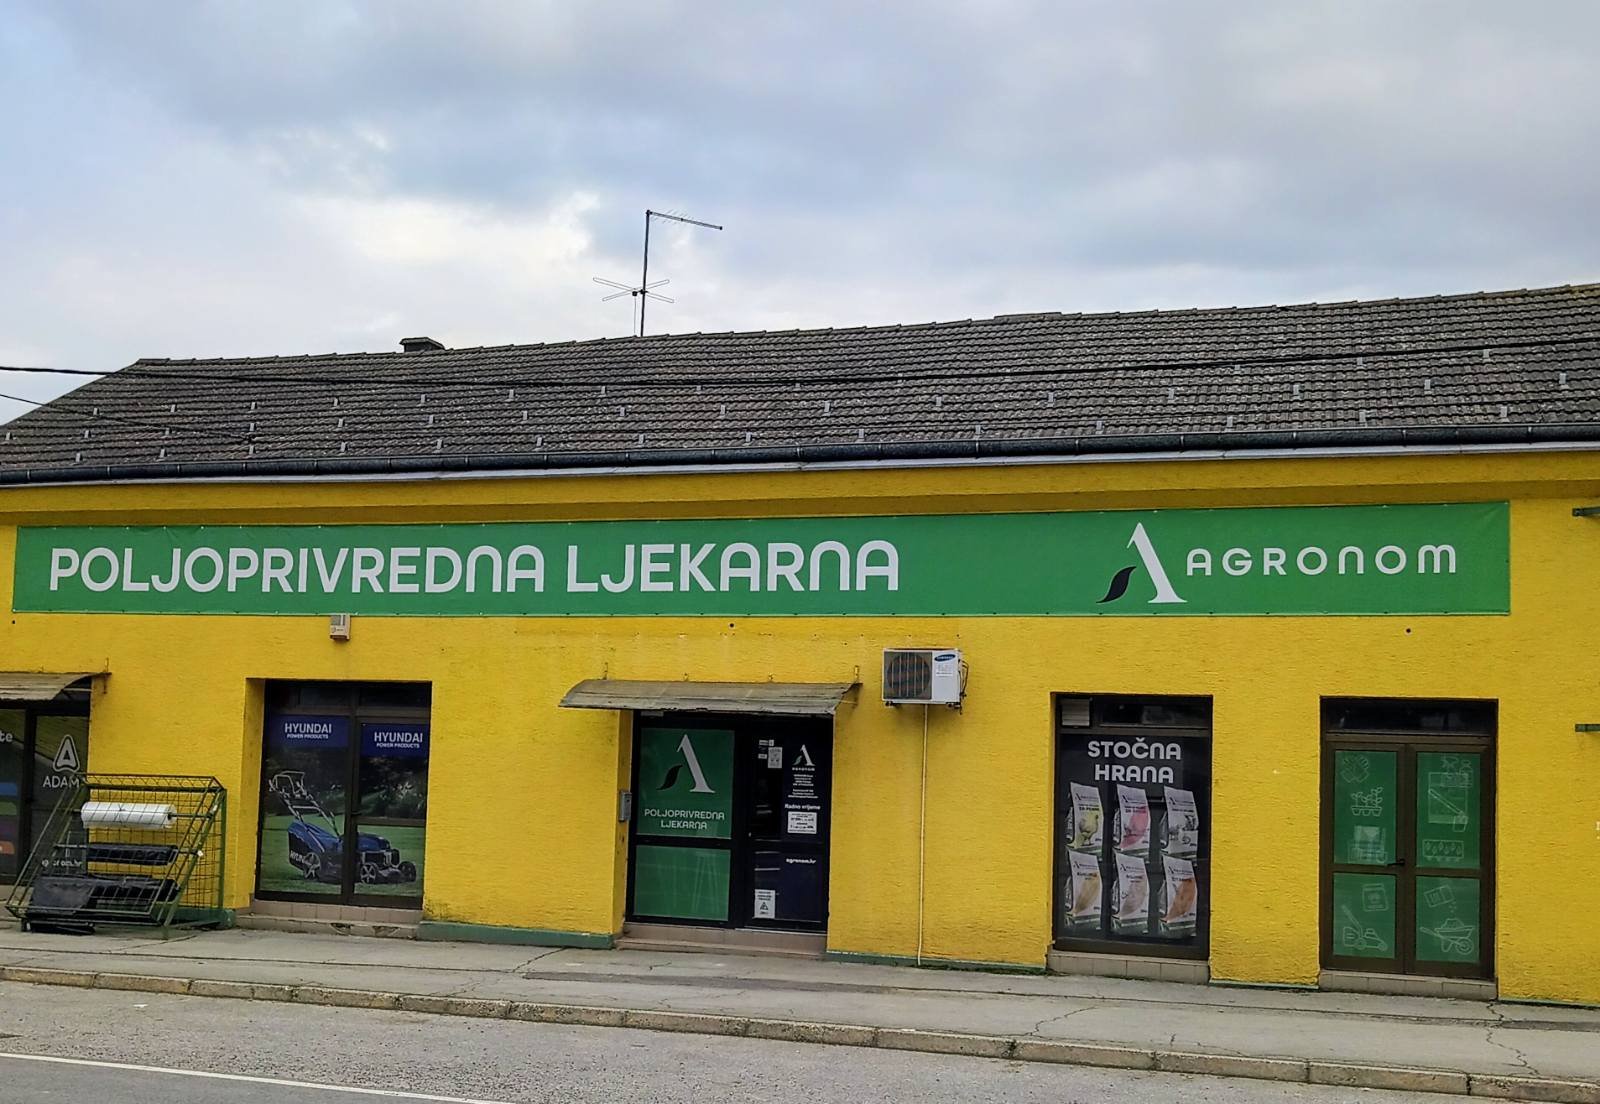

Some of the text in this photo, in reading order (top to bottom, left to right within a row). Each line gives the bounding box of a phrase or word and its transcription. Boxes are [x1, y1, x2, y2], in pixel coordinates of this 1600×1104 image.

[49, 540, 899, 593] POLJOPRIVREDNA LJEKARNA
[1186, 544, 1456, 576] AGRONOM
[284, 722, 332, 734] HYUNDAI
[374, 732, 423, 743] HYUNDAI
[1087, 737, 1181, 760] STOČNA
[1094, 764, 1174, 783] HRANA
[42, 775, 82, 788] ADAM
[644, 808, 725, 820] POLJOPRIVREDNA
[660, 820, 708, 830] LJEKARNA
